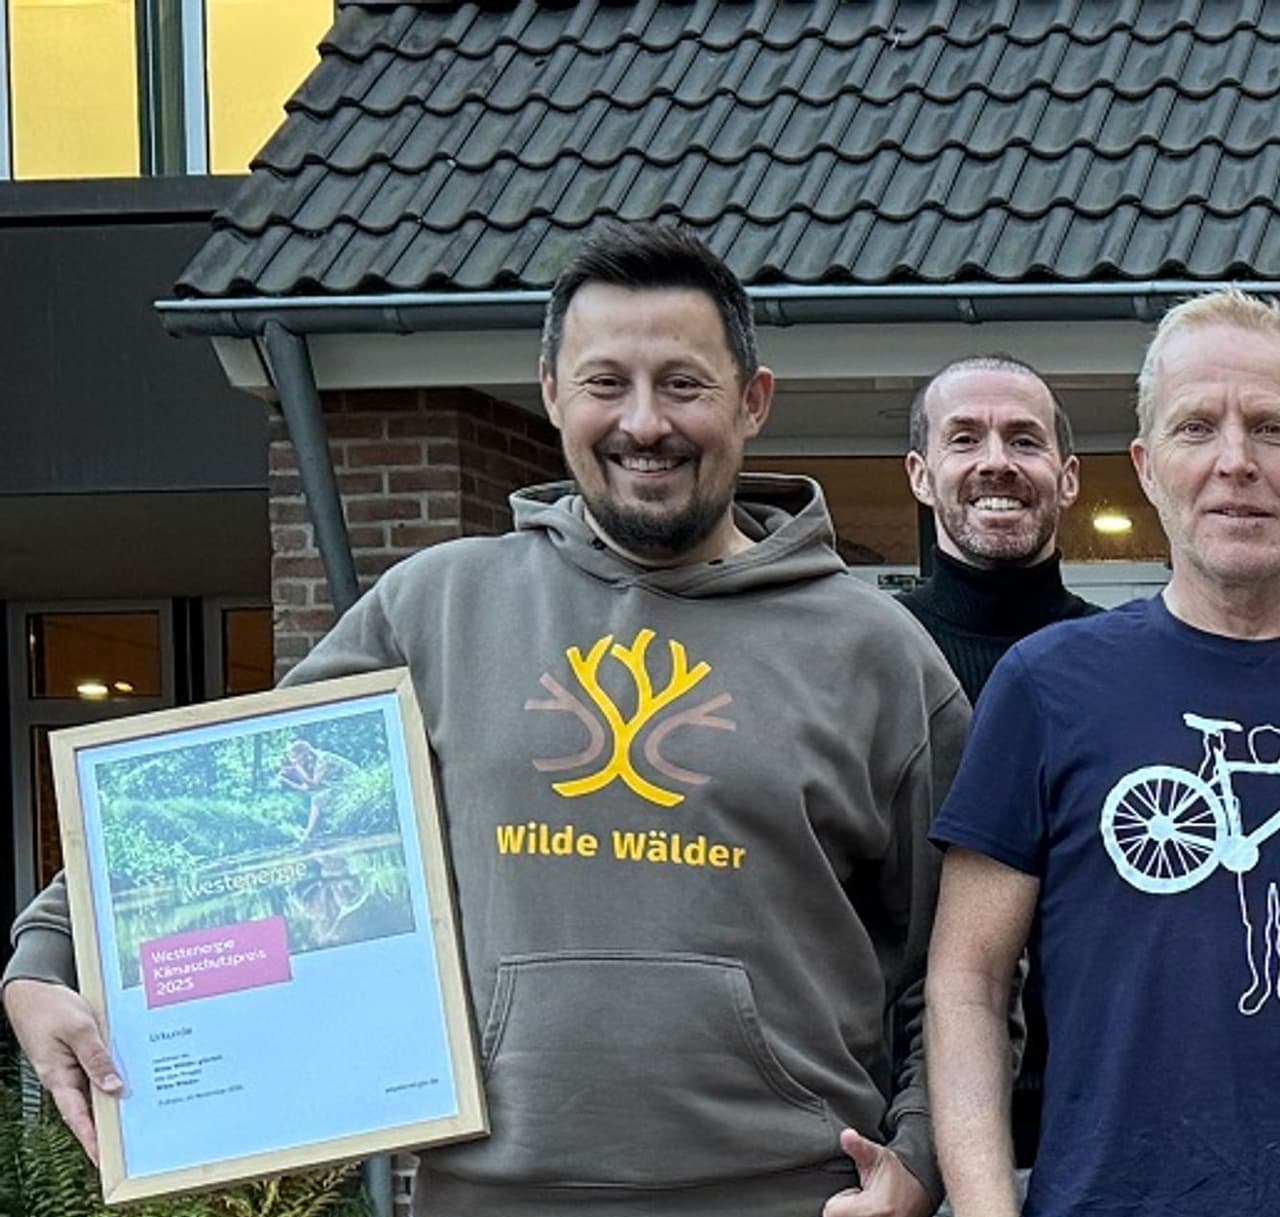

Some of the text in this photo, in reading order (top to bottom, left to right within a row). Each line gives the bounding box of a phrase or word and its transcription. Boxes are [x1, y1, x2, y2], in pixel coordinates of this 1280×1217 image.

[497, 821, 747, 869] Wilde Wälder
[183, 861, 308, 903] westenergie
[151, 938, 236, 964] Westenergie
[156, 976, 195, 996] 2025
